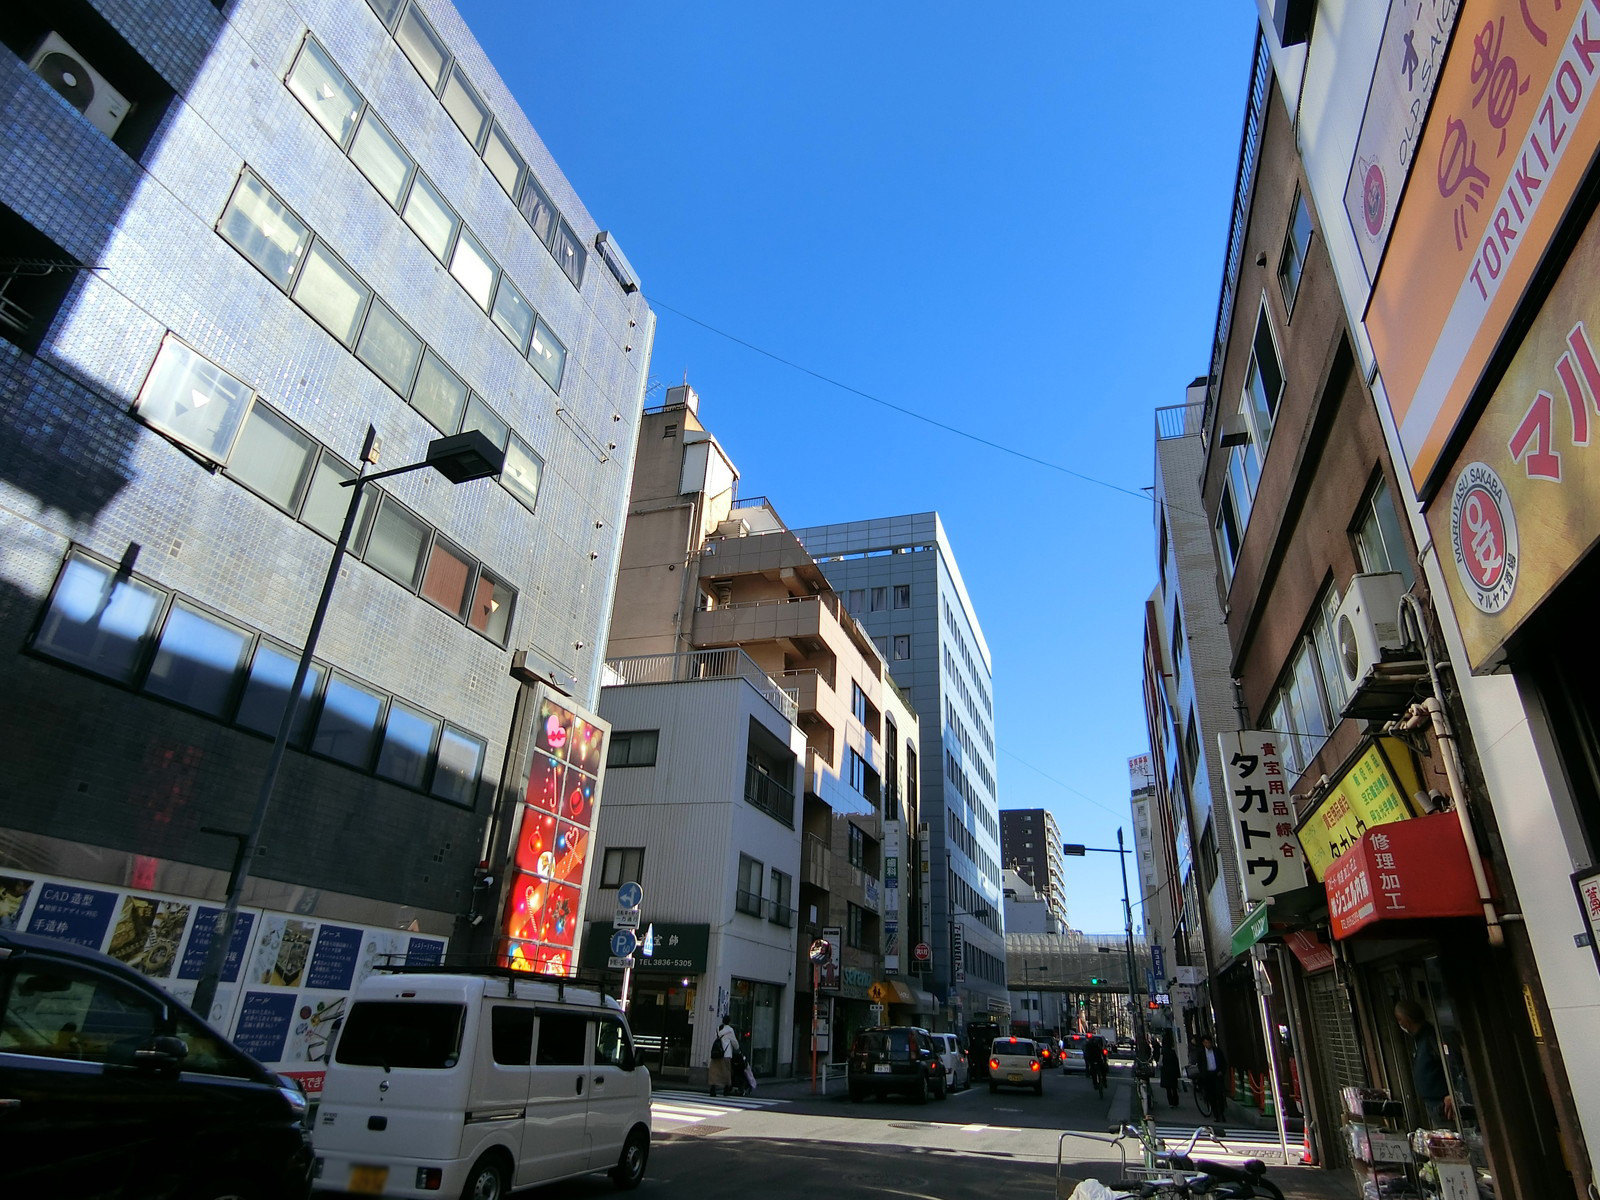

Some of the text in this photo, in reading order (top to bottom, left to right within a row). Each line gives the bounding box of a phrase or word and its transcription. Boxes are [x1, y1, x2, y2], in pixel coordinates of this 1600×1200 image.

[1399, 98, 1421, 167] OLD
[1469, 0, 1600, 301] TORIKIZOK
[1452, 467, 1503, 564] MARUYASU SAKABA
[1230, 752, 1279, 887] タカトウ
[44, 889, 69, 902] CAD
[1369, 833, 1406, 910] 修理加工
[616, 936, 627, 953] P
[639, 958, 653, 967] TEL
[653, 958, 692, 968] 3836-5305
